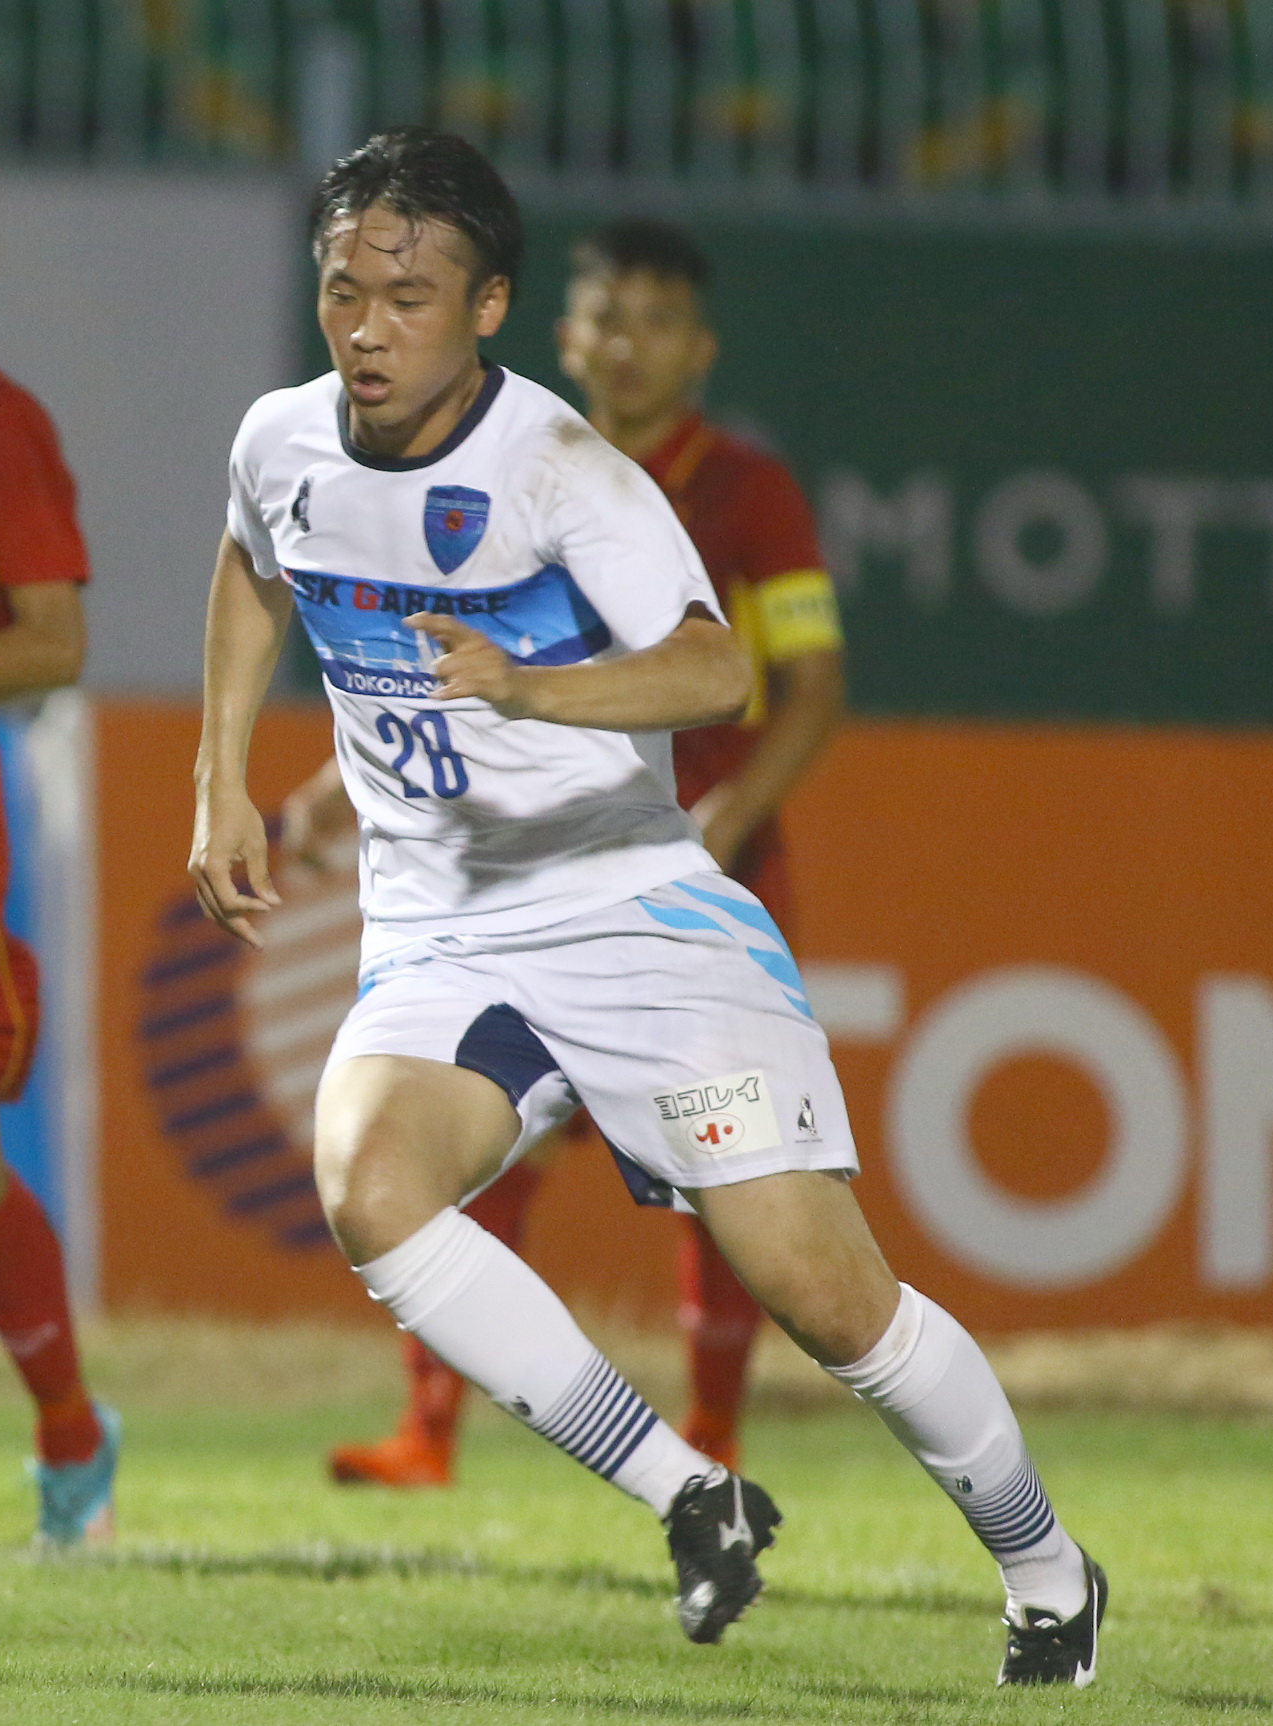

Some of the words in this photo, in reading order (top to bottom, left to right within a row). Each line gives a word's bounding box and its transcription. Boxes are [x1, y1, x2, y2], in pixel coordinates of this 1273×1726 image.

[352, 581, 509, 617] GARAGE
[376, 710, 469, 799] 28
[654, 1076, 760, 1120] ヨコレイ
